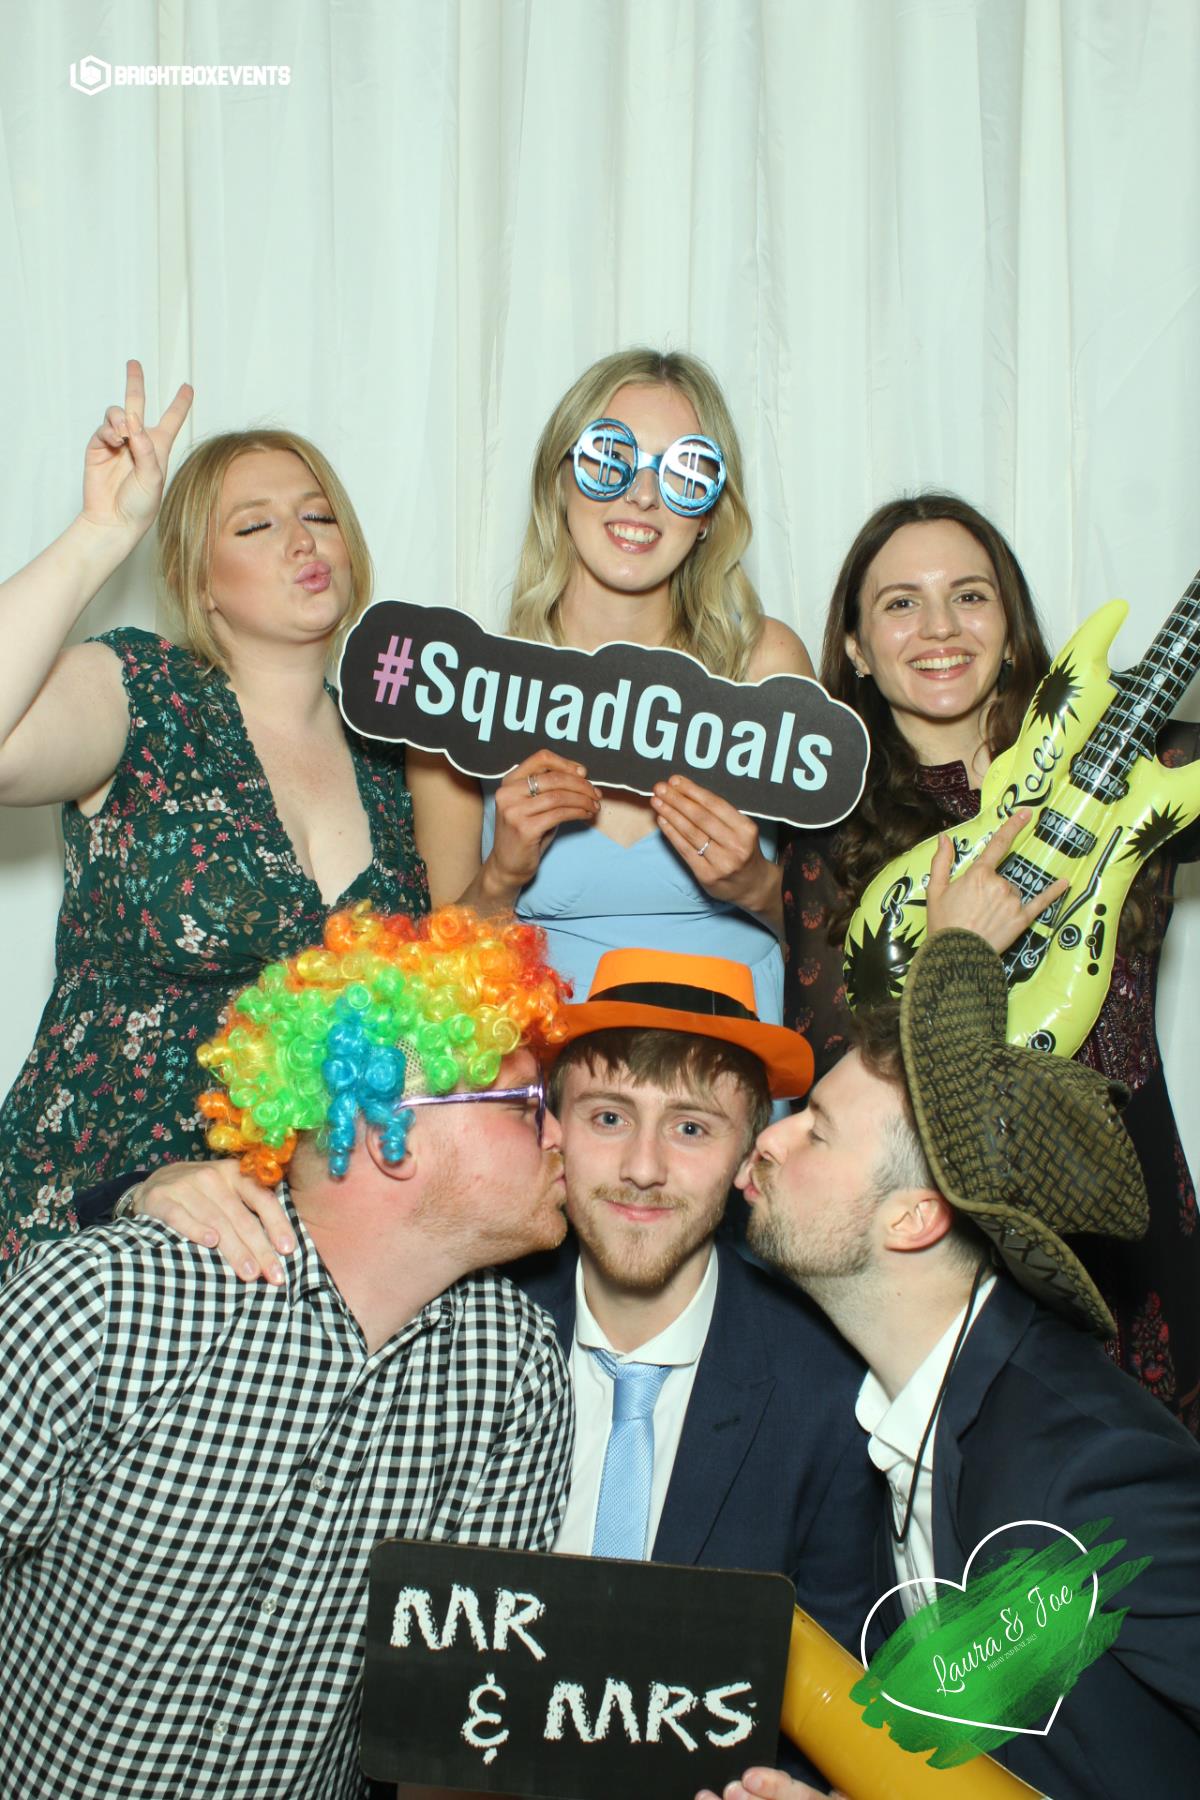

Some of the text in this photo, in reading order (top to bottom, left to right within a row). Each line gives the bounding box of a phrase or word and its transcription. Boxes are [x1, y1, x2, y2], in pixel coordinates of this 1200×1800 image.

[373, 635, 833, 791] #SquadGoals
[996, 735, 1064, 819] Roll
[390, 1583, 547, 1661] MR
[460, 1673, 758, 1765] & MRS
